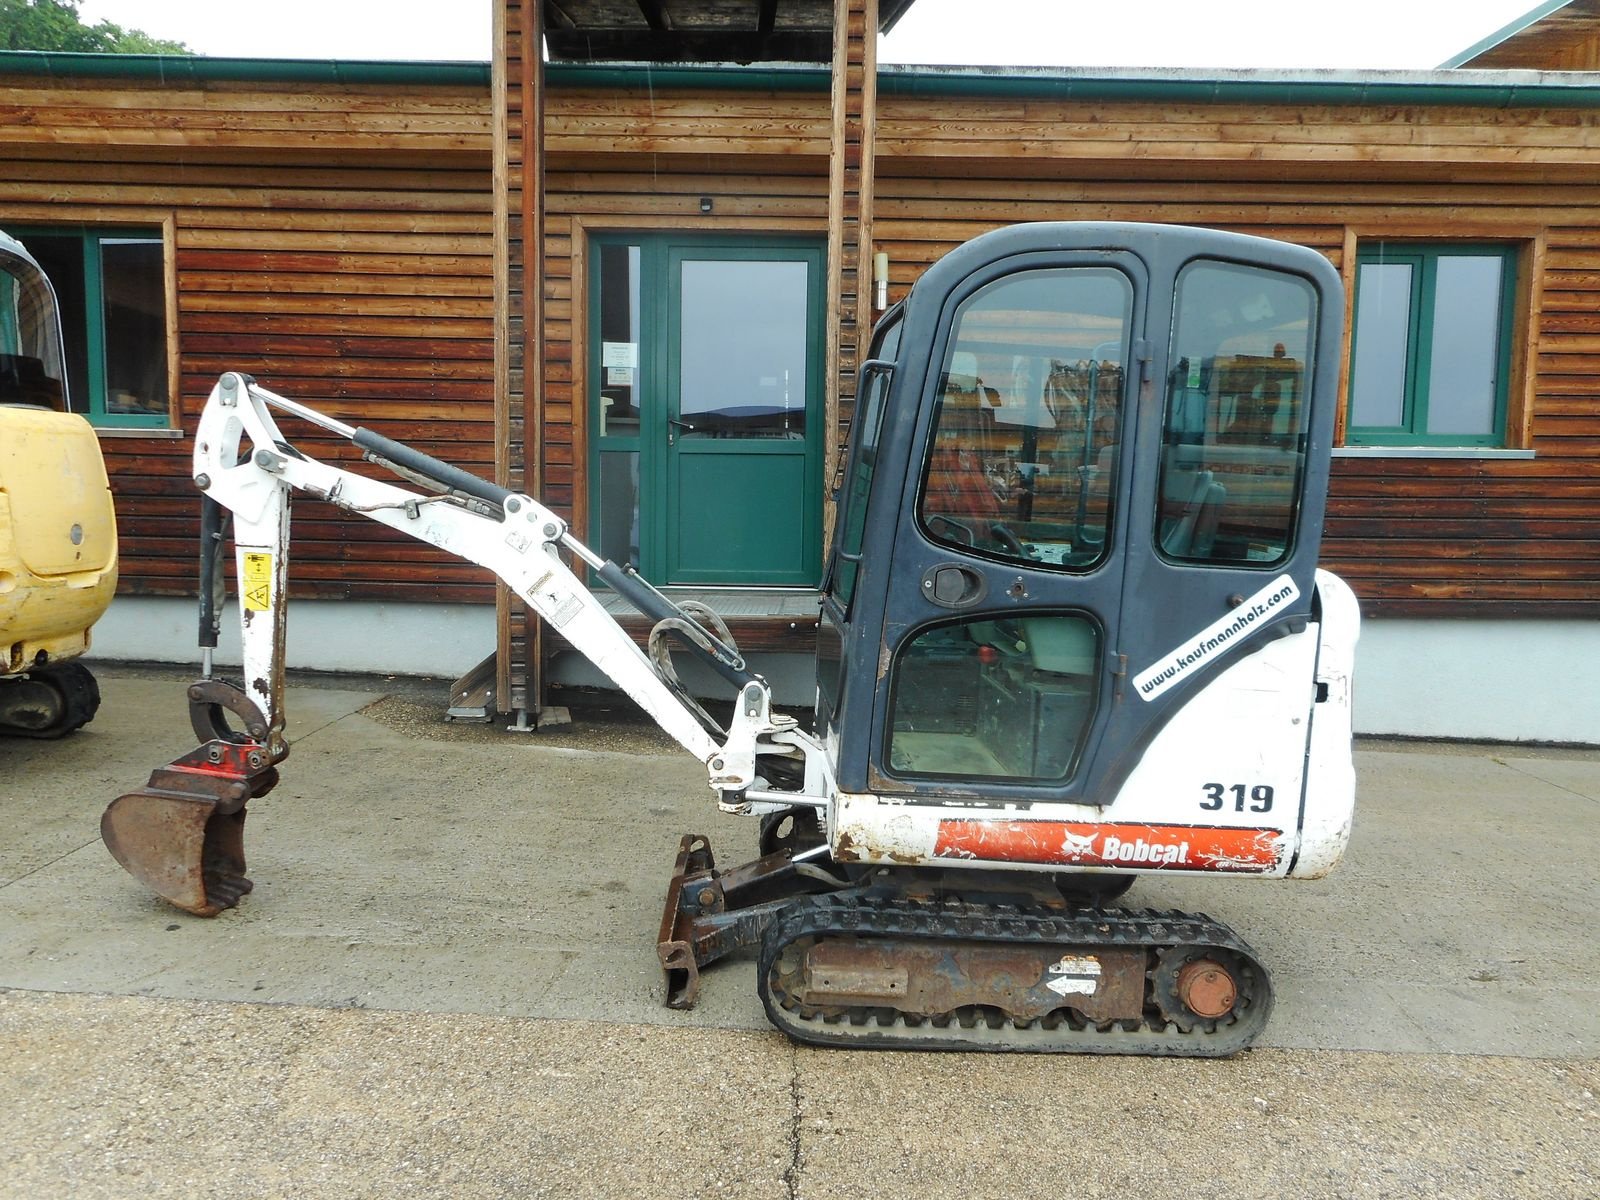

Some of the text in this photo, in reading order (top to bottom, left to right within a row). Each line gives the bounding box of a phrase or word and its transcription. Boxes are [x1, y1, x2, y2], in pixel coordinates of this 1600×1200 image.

[1141, 584, 1293, 694] www.kaufmannholz.com
[1199, 783, 1274, 813] 319
[1102, 837, 1189, 864] Bobcat
